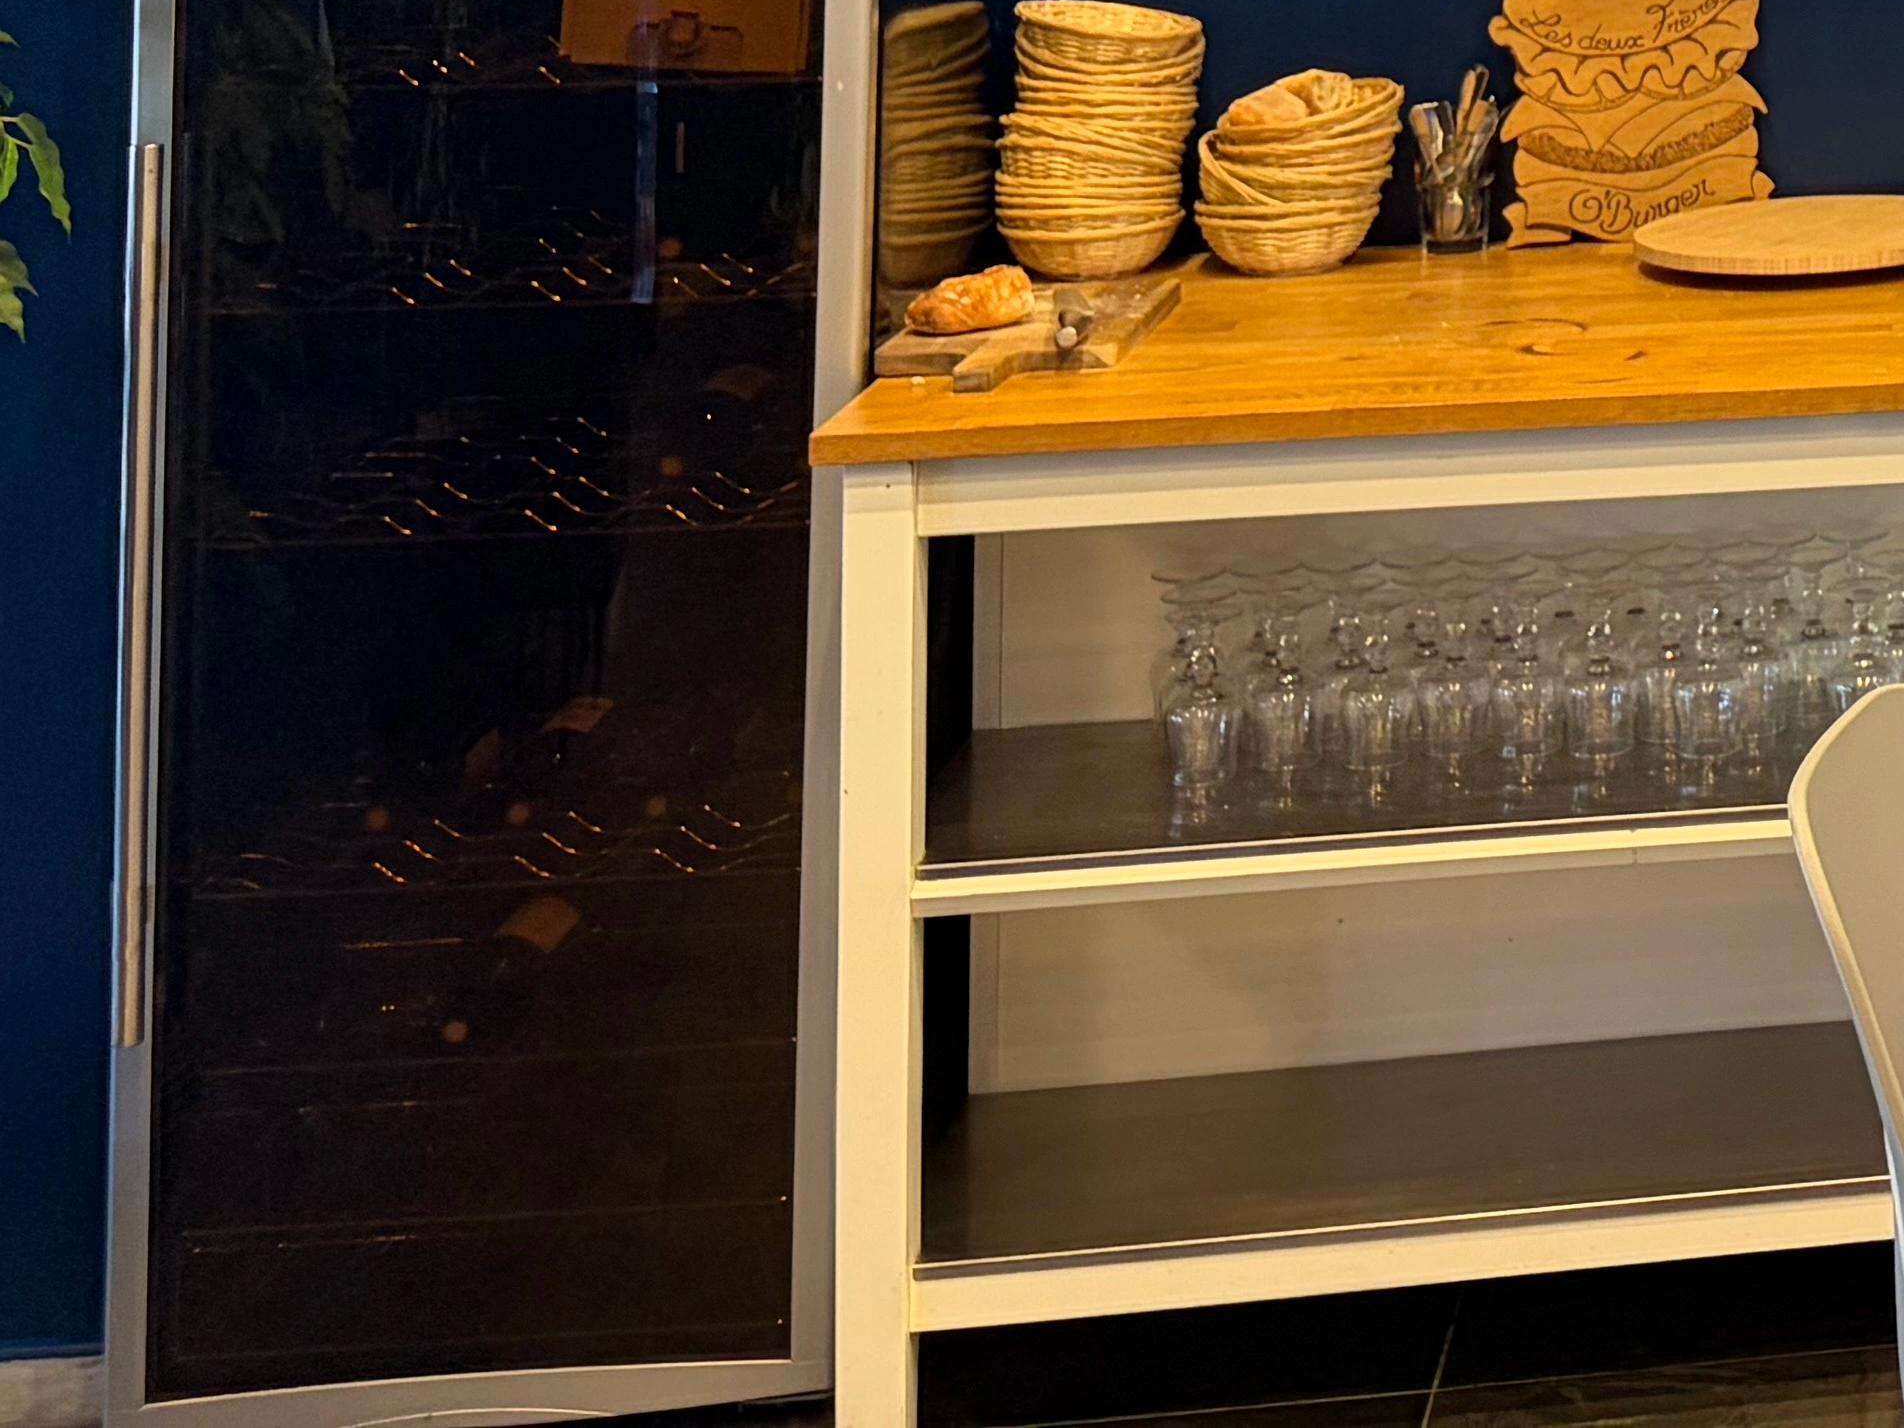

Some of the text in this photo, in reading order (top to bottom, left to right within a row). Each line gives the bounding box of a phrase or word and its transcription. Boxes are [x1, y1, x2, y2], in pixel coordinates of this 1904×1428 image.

[1520, 10, 1573, 48] Les
[1578, 24, 1646, 51] deux
[1569, 179, 1717, 234] O'Burger
